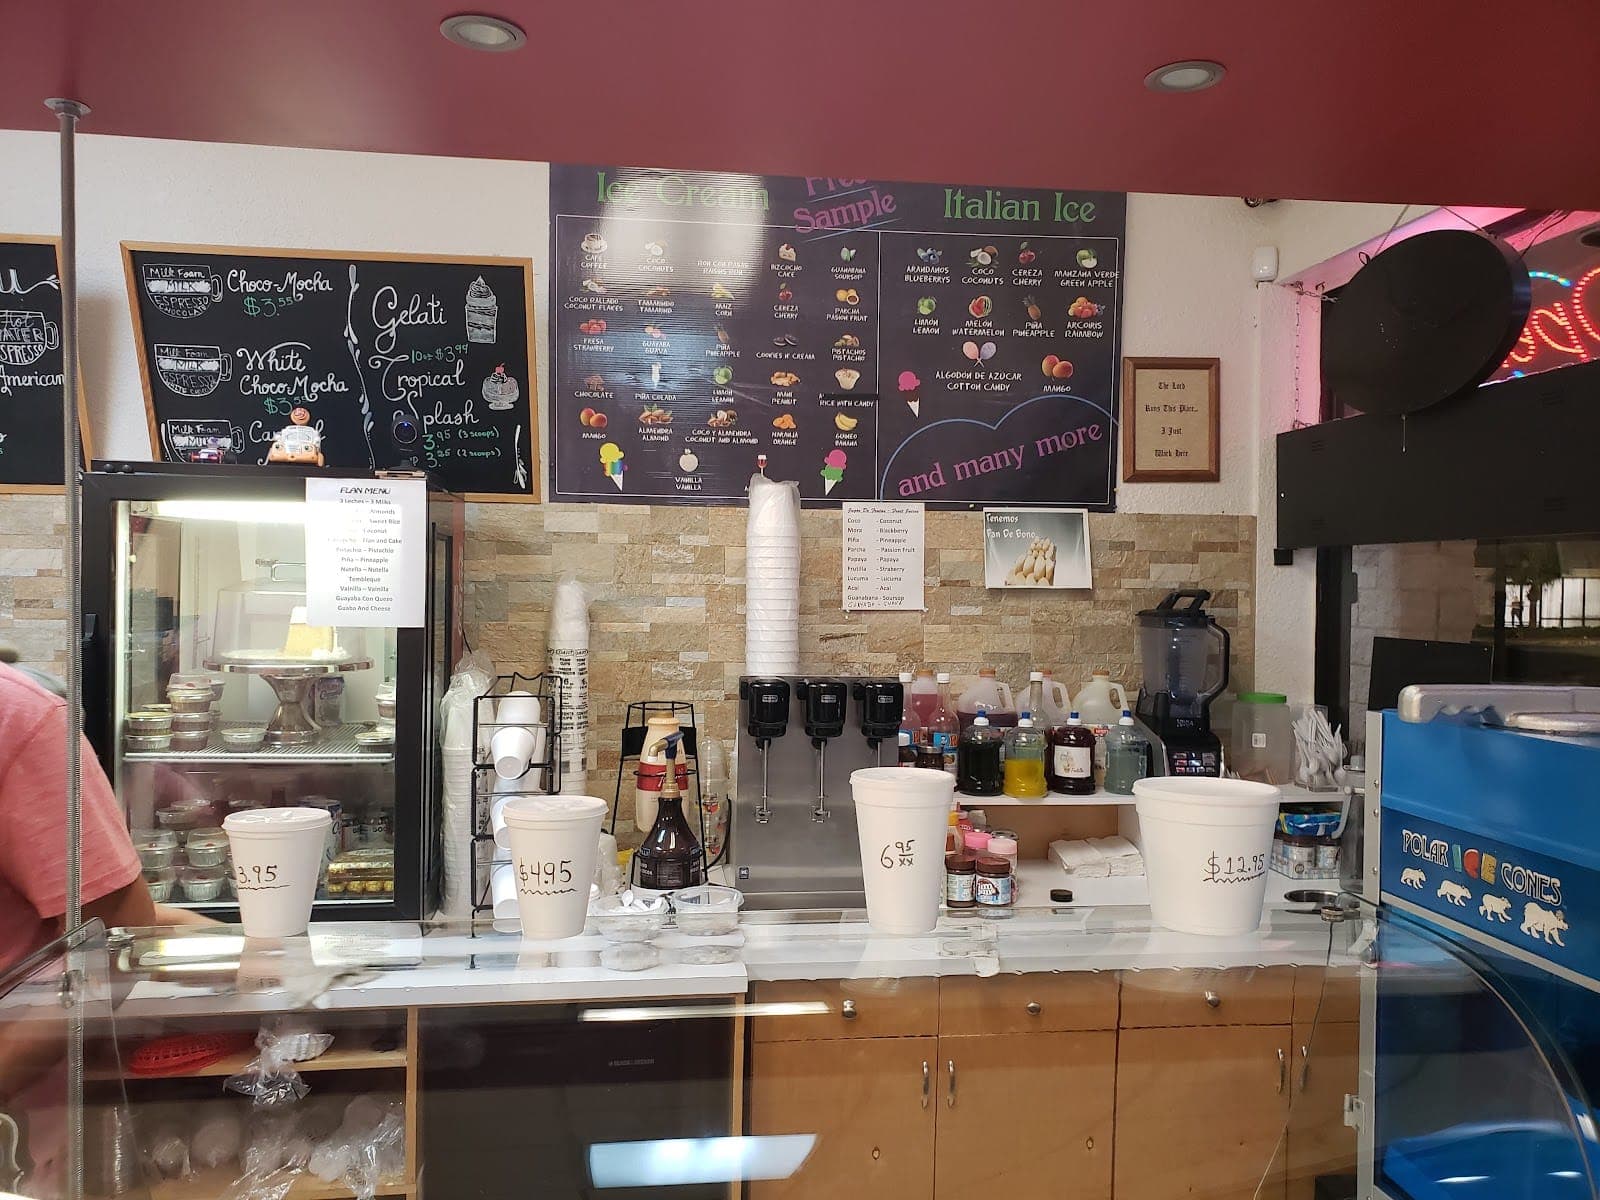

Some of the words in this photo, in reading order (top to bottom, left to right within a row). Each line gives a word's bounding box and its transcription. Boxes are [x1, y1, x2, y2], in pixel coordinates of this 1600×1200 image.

[943, 188, 1040, 222] Italian
[1053, 192, 1096, 224] Ice
[793, 189, 897, 234] Sample
[150, 267, 175, 278] Milk
[178, 269, 205, 278] Foam
[777, 270, 796, 278] CAKE
[906, 265, 949, 274] ARANDANOS
[1012, 269, 1043, 277] CEREZA
[904, 274, 951, 284] BLUEBERRYS
[1054, 270, 1092, 278] MANZANA
[1094, 271, 1120, 279] VERDE
[227, 269, 333, 301] Choco-Mocha
[961, 276, 1004, 285] COCONUTS
[1012, 278, 1042, 286] CHERRY
[1060, 279, 1085, 287] GREEN
[1087, 279, 1113, 288] APPLE
[154, 296, 209, 309] ESPRESSO
[598, 304, 624, 312] FLAKES
[372, 286, 448, 353] Gelati
[1066, 321, 1103, 329] ARCOIRIS
[912, 327, 940, 335] LEMON
[952, 328, 1005, 336] WATERMELON
[1012, 329, 1056, 337] PINEAPPLE
[1064, 330, 1104, 338] RAINBOW
[0, 344, 45, 363] SPRESSO
[236, 341, 311, 372] White
[705, 350, 740, 358] PINEAPPLE
[368, 355, 465, 401] Tropical
[974, 371, 985, 380] DE
[239, 373, 349, 402] Choco-Mocha
[947, 381, 981, 391] COTTON
[983, 382, 1011, 392] CANDY
[1043, 385, 1071, 393] MANGO
[574, 391, 614, 399] CHOCOLATE
[771, 397, 797, 405] PEANUT
[854, 400, 874, 408] CANDY
[1168, 427, 1182, 435] Just
[642, 434, 669, 442] ALMOND
[773, 438, 797, 446] ORANGE
[898, 462, 947, 497] and
[953, 444, 1025, 481] many
[1035, 423, 1103, 457] more
[986, 513, 1019, 523] Tenemos
[986, 529, 1001, 538] Pan
[1003, 529, 1013, 538] De
[1016, 529, 1036, 538] Bono
[1203, 850, 1265, 880] $12.95
[1402, 829, 1449, 868] POLAR
[1452, 843, 1498, 885] ICE
[1501, 862, 1562, 906] CONES
